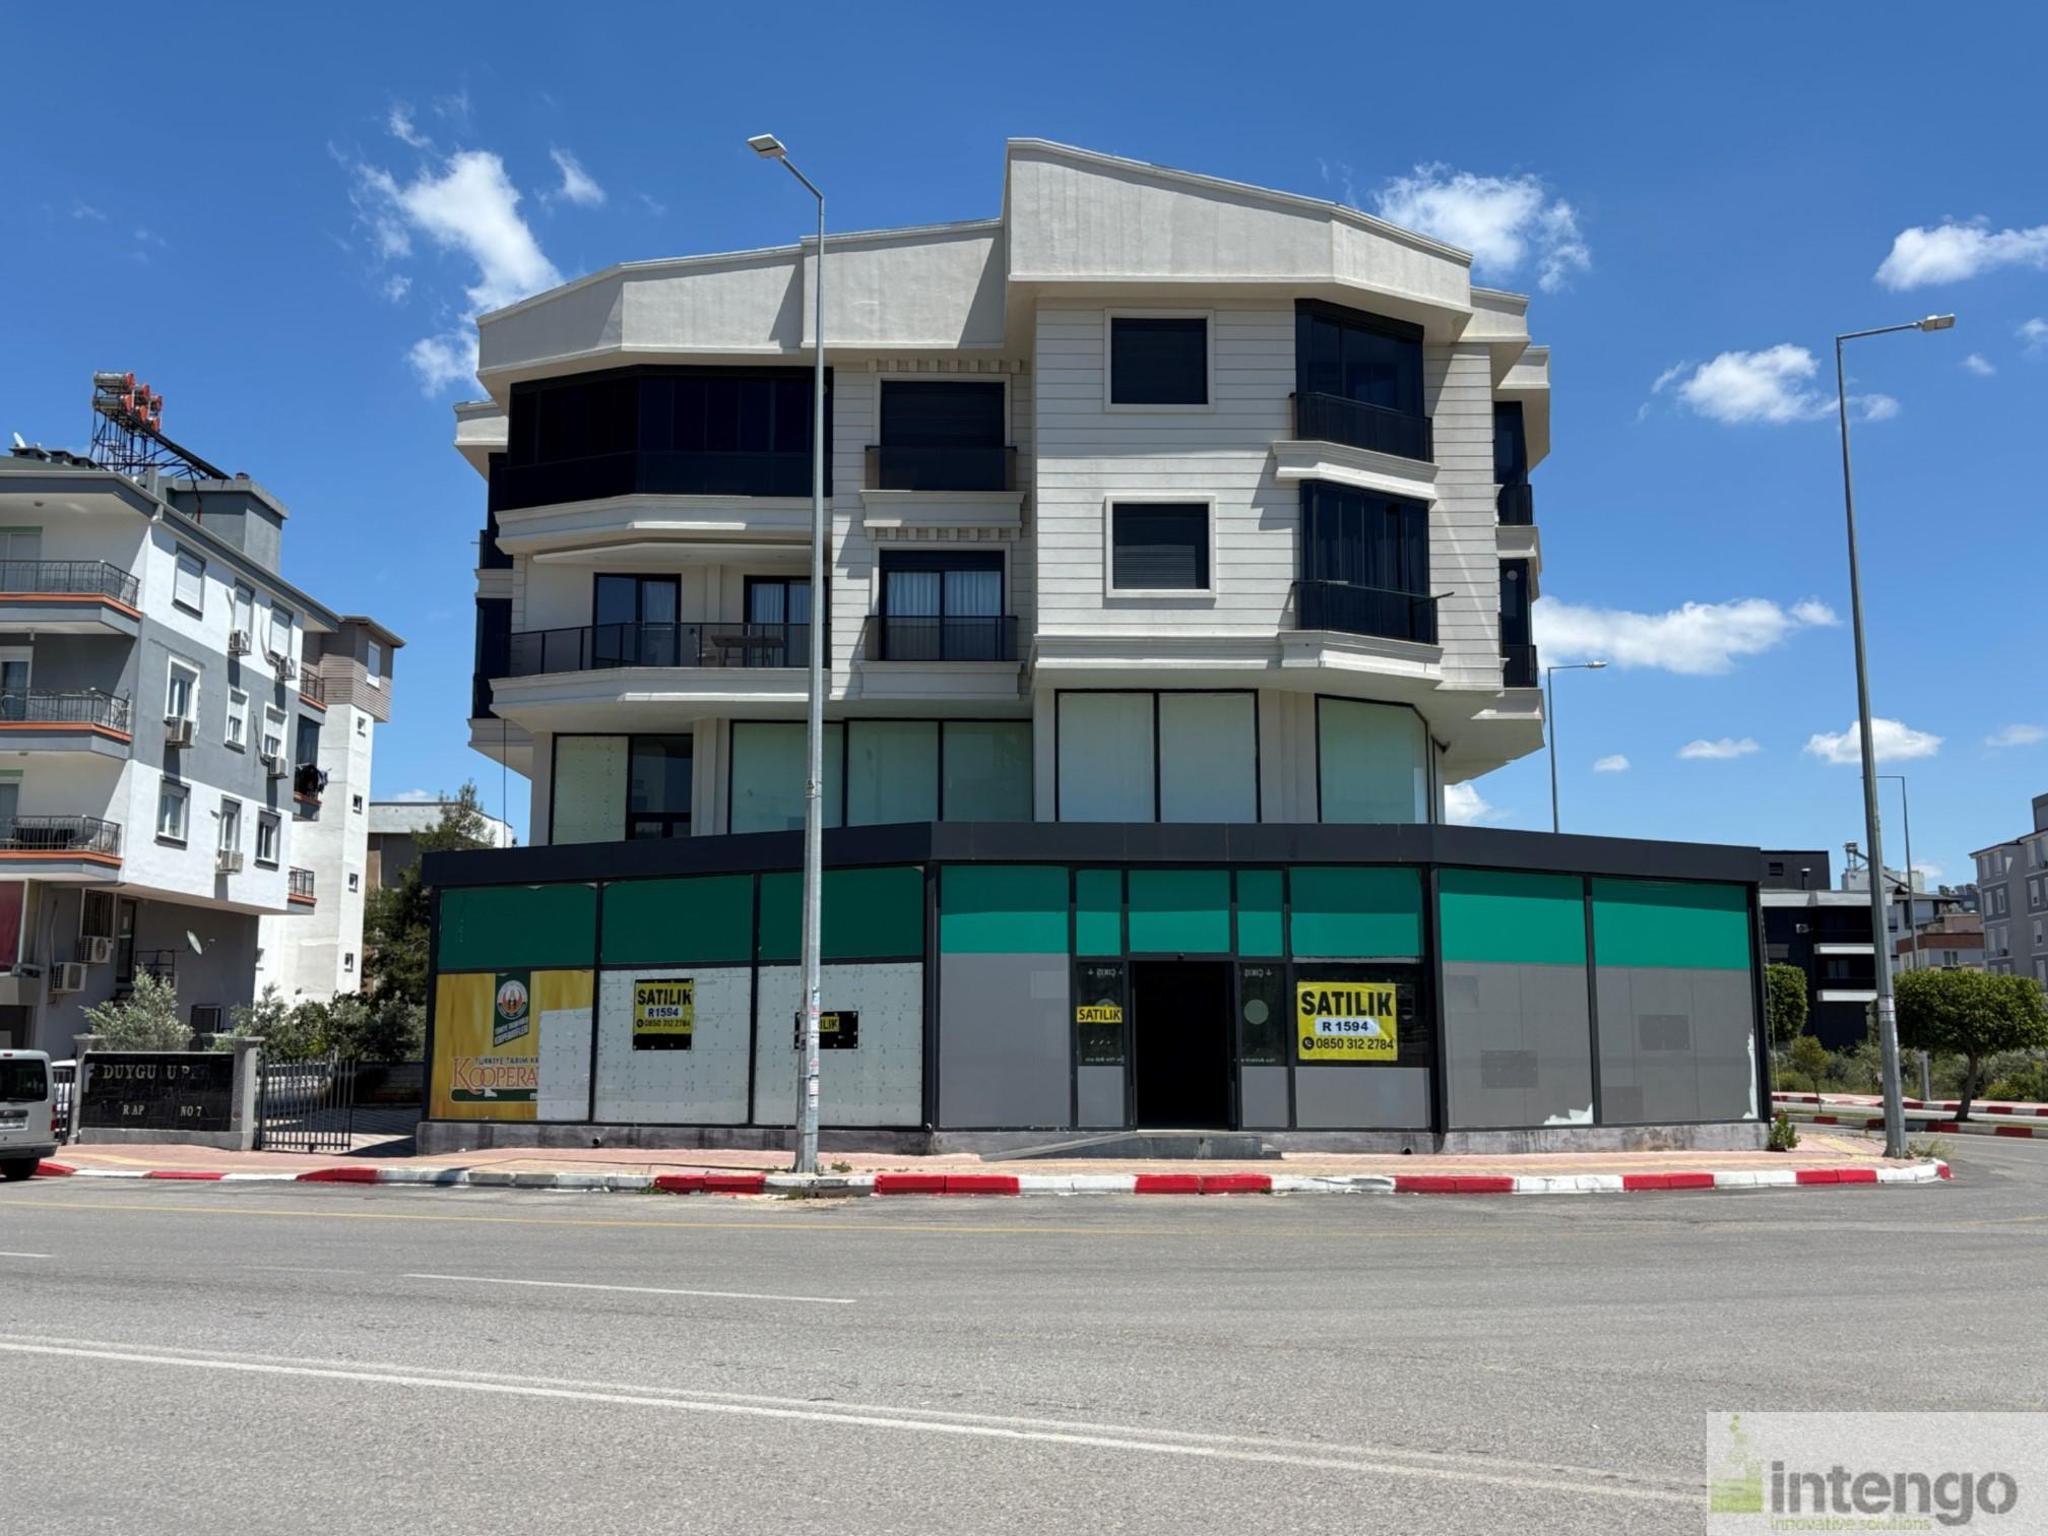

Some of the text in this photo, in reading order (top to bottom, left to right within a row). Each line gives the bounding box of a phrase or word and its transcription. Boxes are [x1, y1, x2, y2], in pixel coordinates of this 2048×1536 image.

[637, 989, 692, 1006] SATILIK
[1301, 990, 1393, 1016] SATILIK
[1079, 1009, 1121, 1021] SATILIK
[1322, 1021, 1369, 1032] R 1594
[1316, 1039, 1394, 1050] 0850 312 2784
[103, 1064, 157, 1080] DUYGU
[452, 1058, 539, 1095] KOOPERA
